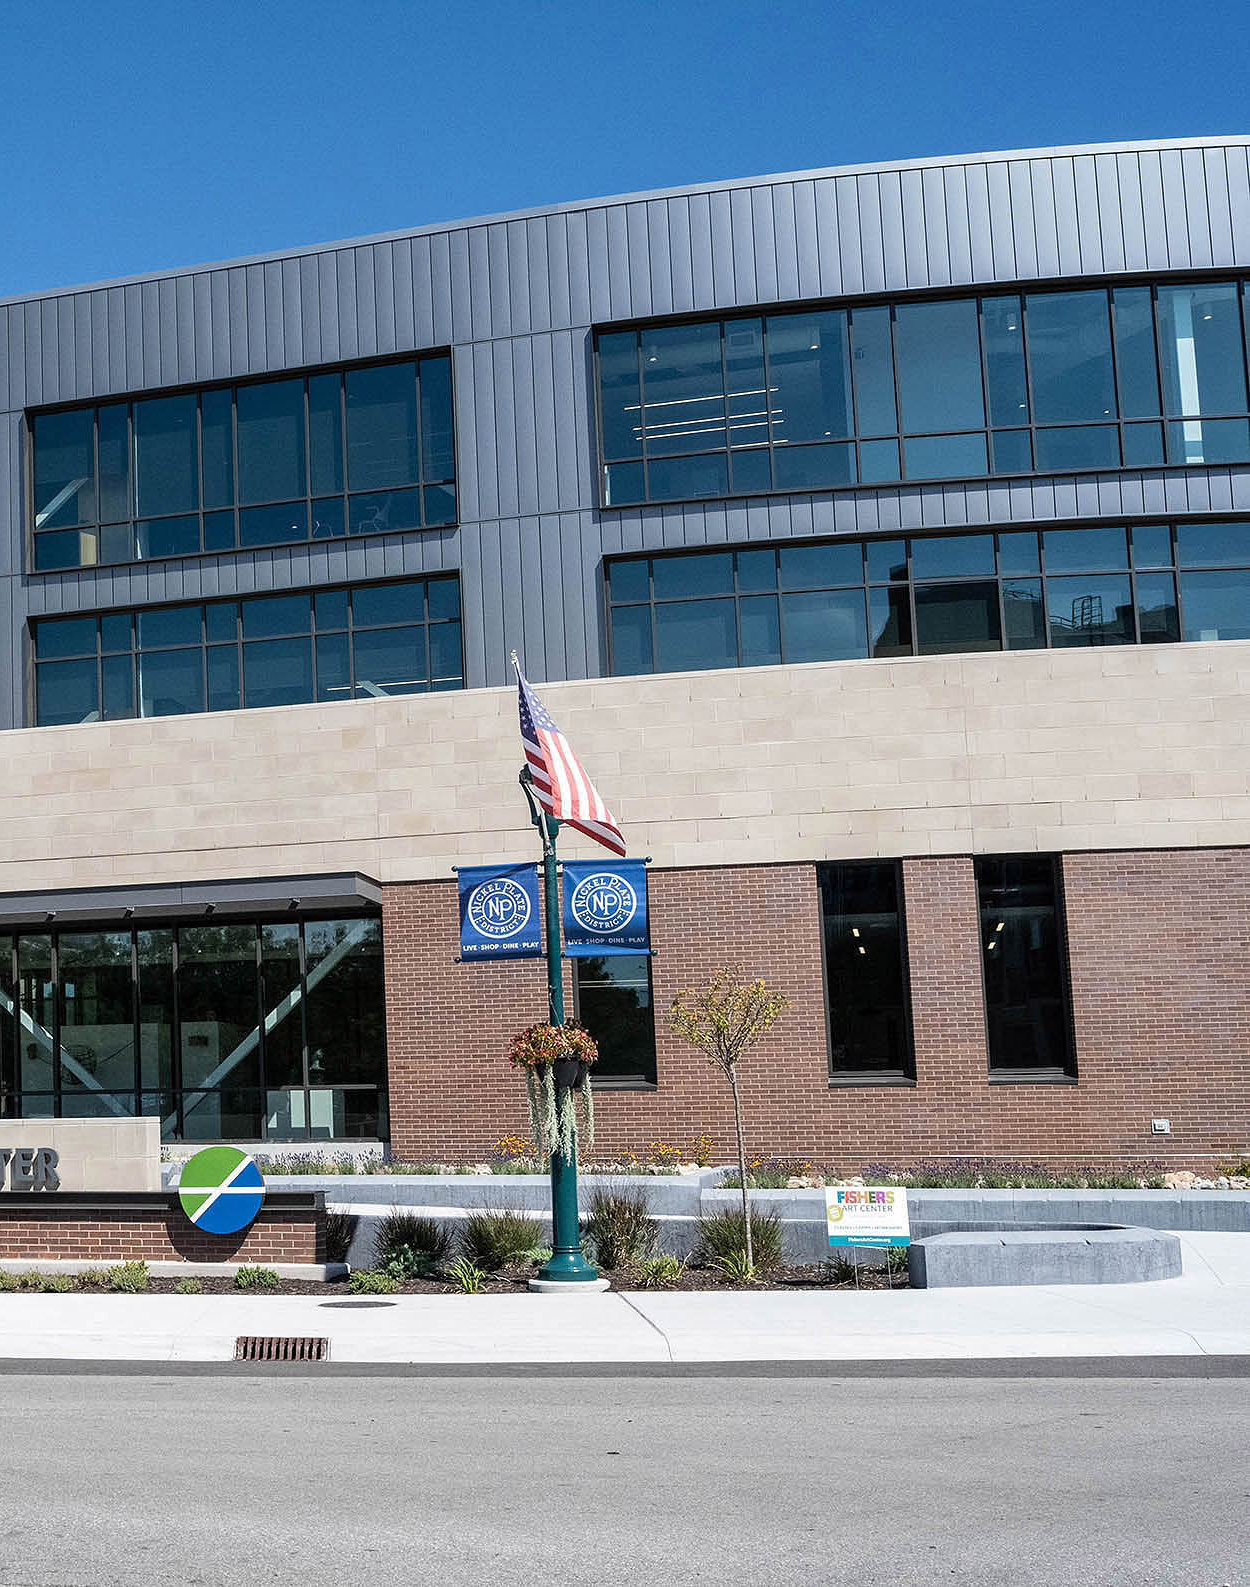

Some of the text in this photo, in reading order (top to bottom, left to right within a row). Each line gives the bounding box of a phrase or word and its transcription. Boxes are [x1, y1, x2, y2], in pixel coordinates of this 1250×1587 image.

[471, 882, 527, 914] NICKEL PLATE
[575, 877, 631, 908] NICKEL PLATE
[488, 896, 513, 921] NP
[592, 891, 618, 916] NP
[481, 918, 520, 934] DISTRICT
[584, 914, 624, 929] DISTRICT
[463, 941, 540, 952] LIVE SHOP DINE PLAY
[837, 1191, 895, 1204] FISHERS
[842, 1205, 857, 1213] ART
[859, 1205, 893, 1213] CENTER
